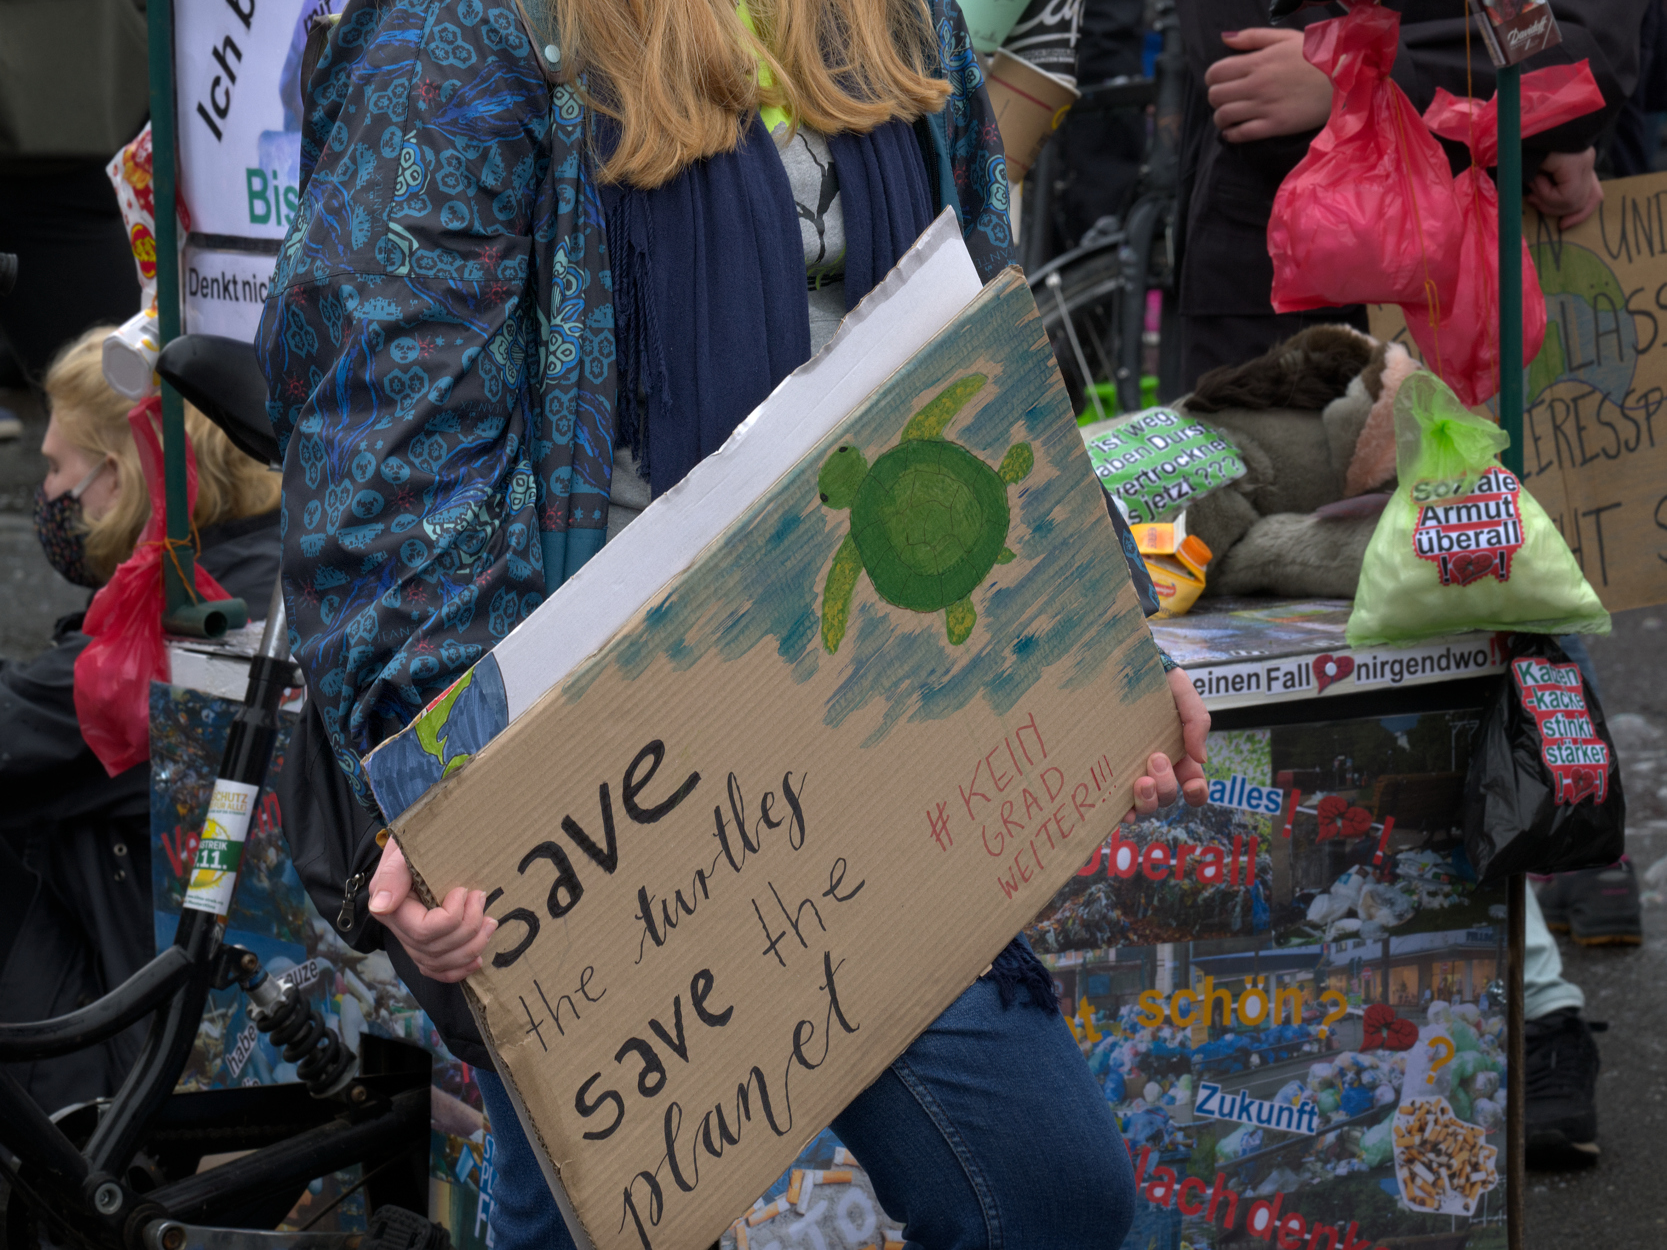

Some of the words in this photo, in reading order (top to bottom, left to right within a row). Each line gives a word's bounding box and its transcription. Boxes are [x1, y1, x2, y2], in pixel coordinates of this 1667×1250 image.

[1506, 14, 1548, 46] Davidoff
[196, 34, 243, 143] Ich
[188, 267, 240, 302] Denkt
[1420, 495, 1514, 528] Armut
[1416, 519, 1520, 555] überall
[1266, 662, 1312, 692] Fall
[1543, 713, 1594, 739] stinkt
[1545, 739, 1607, 765] stärker
[981, 766, 1065, 858] GRAD
[1211, 774, 1283, 814] alles
[518, 965, 608, 1052] the
[634, 771, 809, 965] turtles
[574, 968, 734, 1141] save
[751, 856, 866, 968] the
[1137, 975, 1303, 1028] schön
[225, 1024, 257, 1076] habe
[617, 951, 860, 1250] planet
[1197, 1083, 1318, 1134] Zukunft
